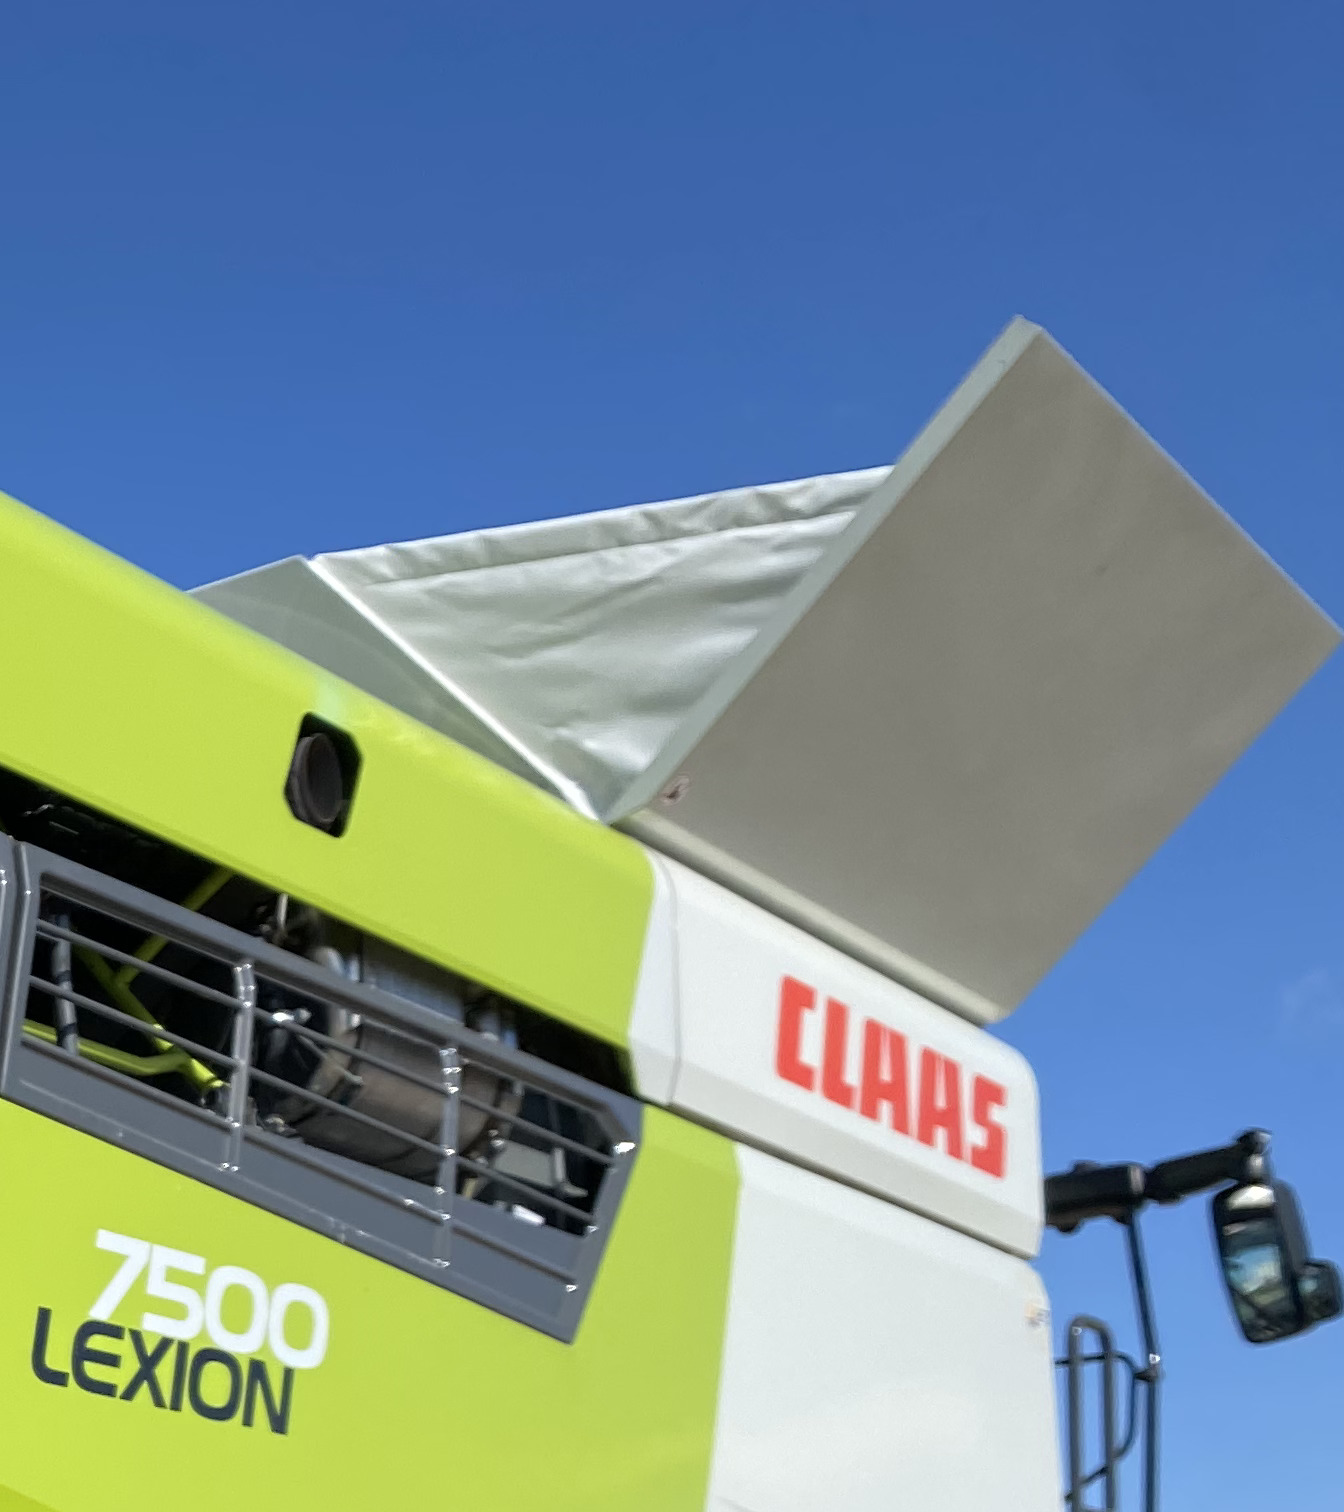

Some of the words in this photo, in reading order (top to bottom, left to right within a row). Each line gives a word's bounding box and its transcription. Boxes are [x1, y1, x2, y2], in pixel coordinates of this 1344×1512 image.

[776, 974, 1008, 1180] CLAAS
[88, 1228, 330, 1369] 7500
[30, 1306, 294, 1436] LEXION
